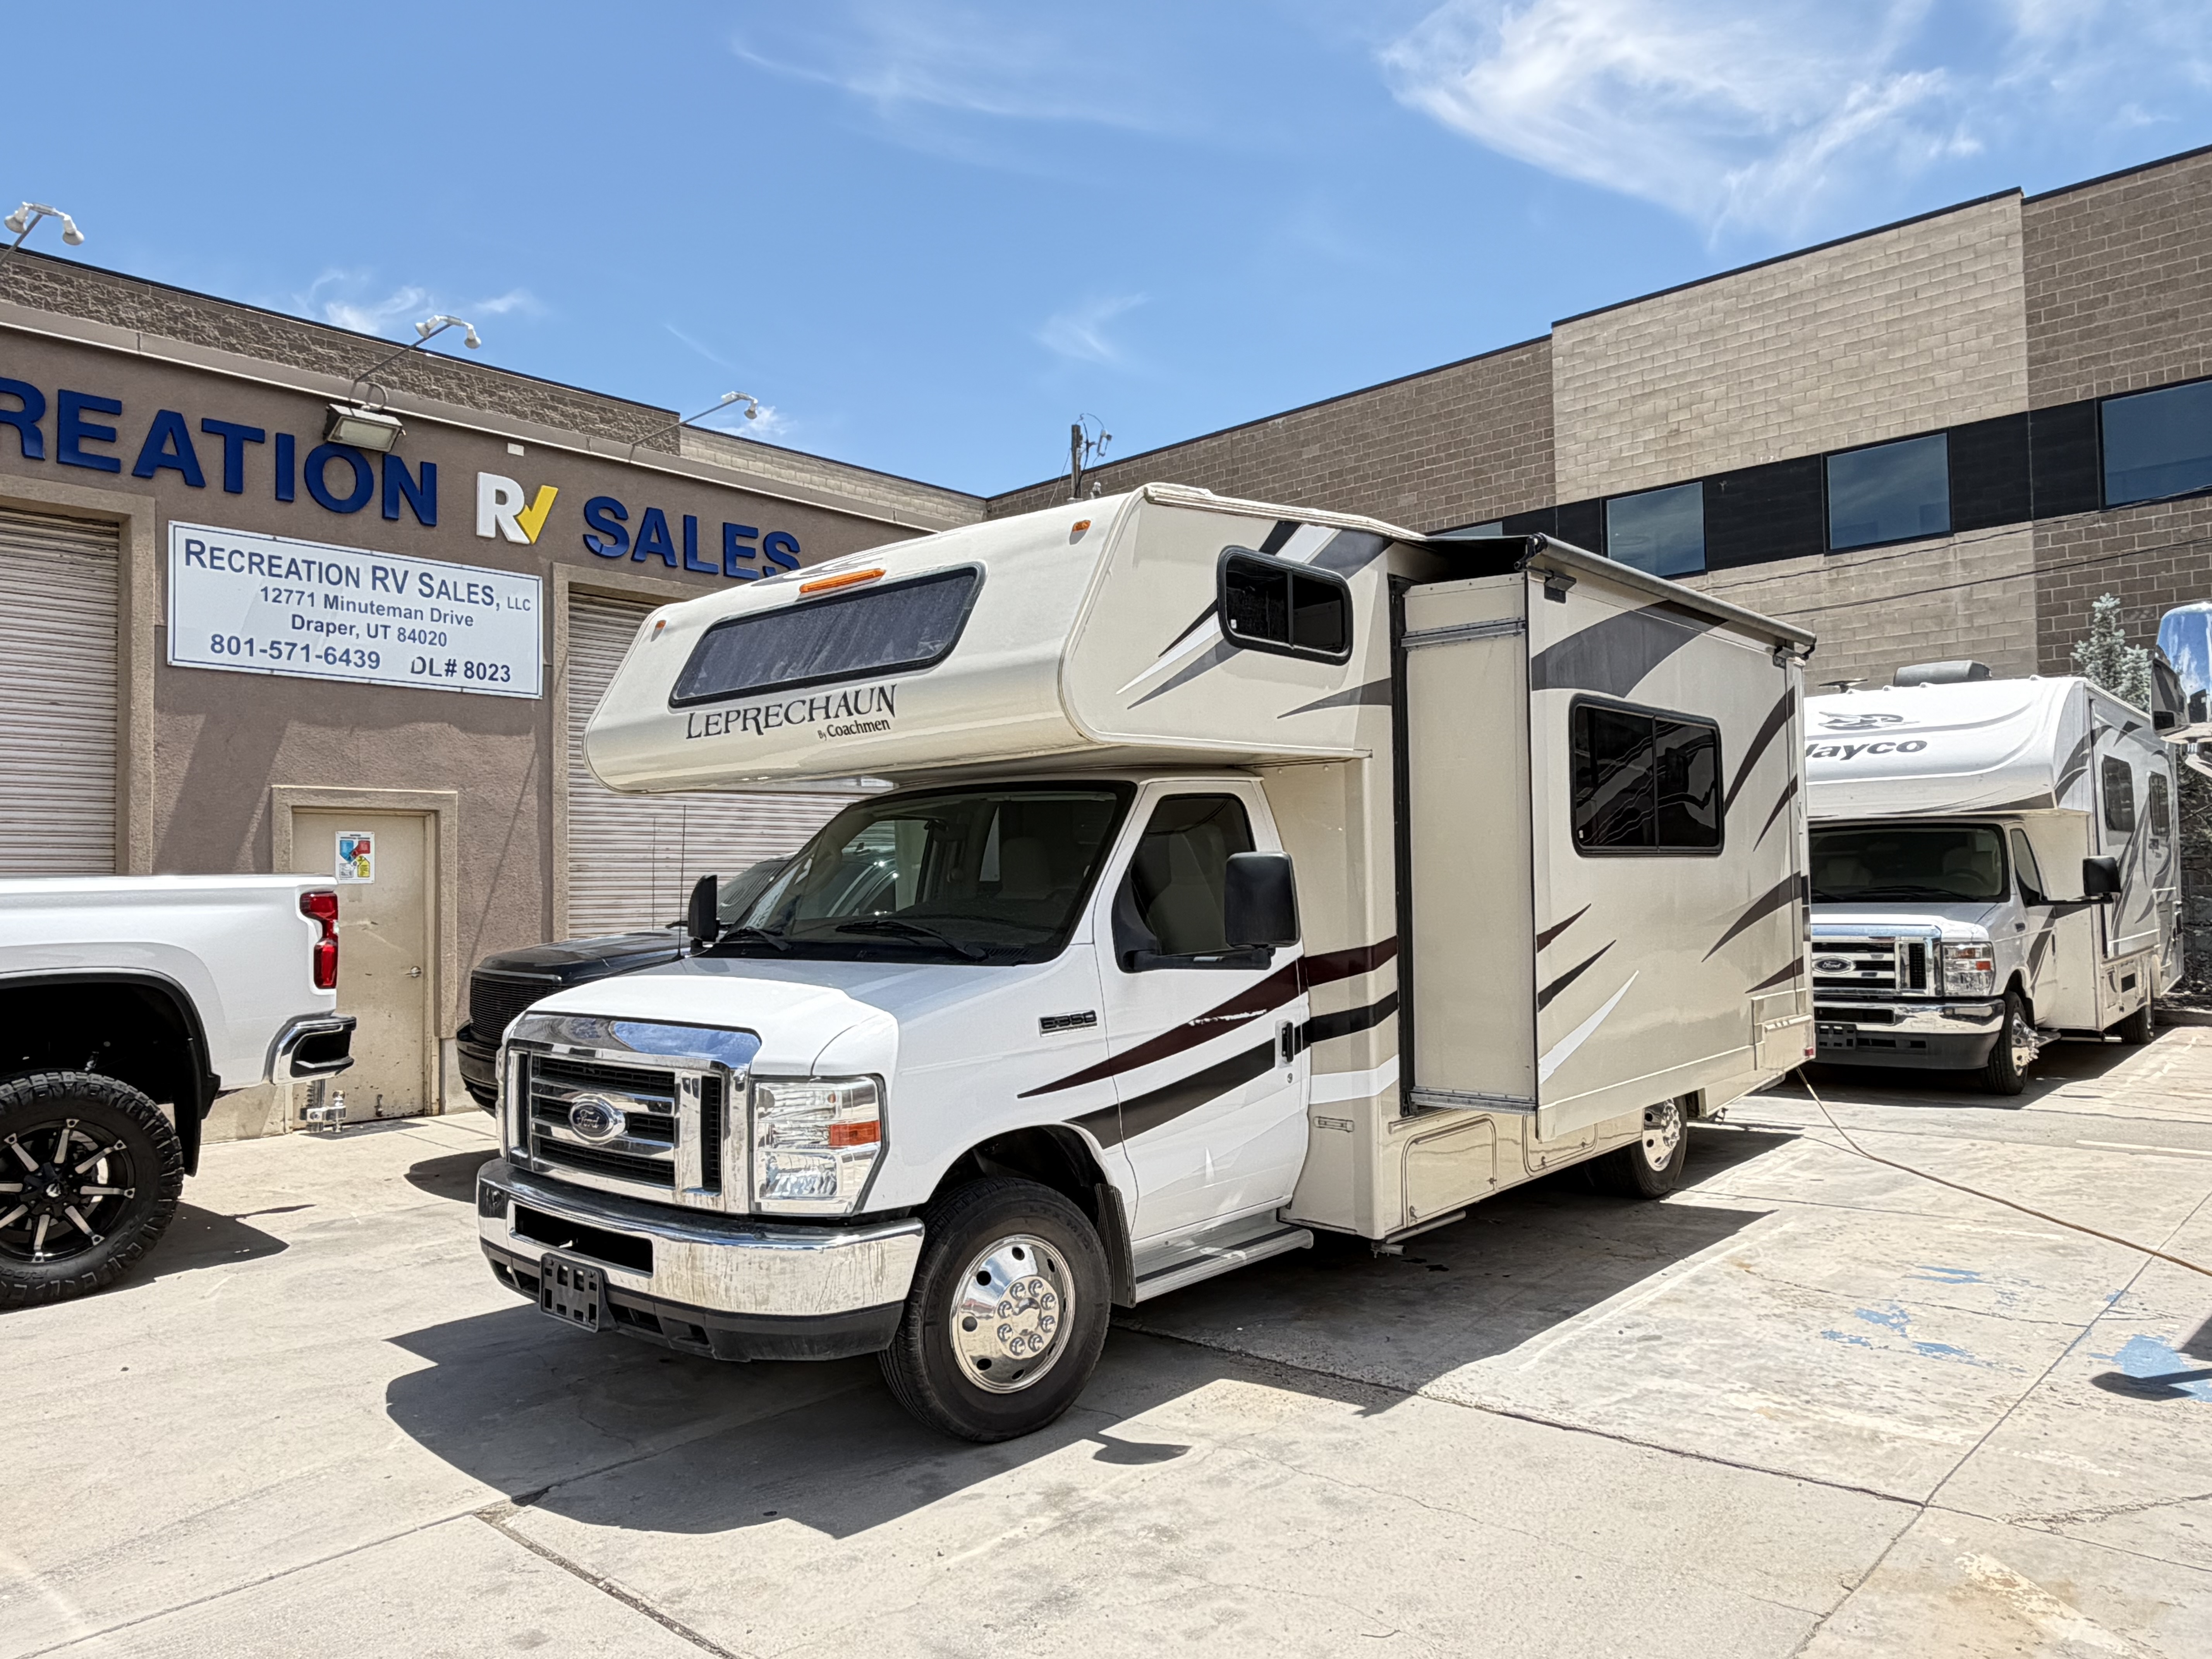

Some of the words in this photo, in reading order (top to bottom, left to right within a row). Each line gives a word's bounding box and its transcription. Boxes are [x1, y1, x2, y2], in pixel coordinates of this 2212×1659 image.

[0, 376, 437, 527] REATION
[476, 471, 558, 544] RV
[582, 496, 801, 580] SALES
[185, 538, 360, 588] RECREATION
[372, 565, 409, 594] RV
[418, 572, 500, 611] SALES,
[507, 596, 531, 611] LLC
[260, 586, 314, 607] 12771
[324, 594, 423, 620] Minuteman
[430, 607, 474, 627] Drive
[291, 613, 359, 639] Draper,
[366, 623, 391, 639] UT
[397, 627, 447, 647] 84020
[211, 634, 380, 669] 801-571-6439
[410, 656, 457, 677] DL#
[464, 661, 510, 683] 8023
[686, 684, 897, 739] LEPRECHAUN
[818, 730, 827, 741] By
[826, 719, 891, 738] Coachmen
[576, 1109, 599, 1128] Ford
